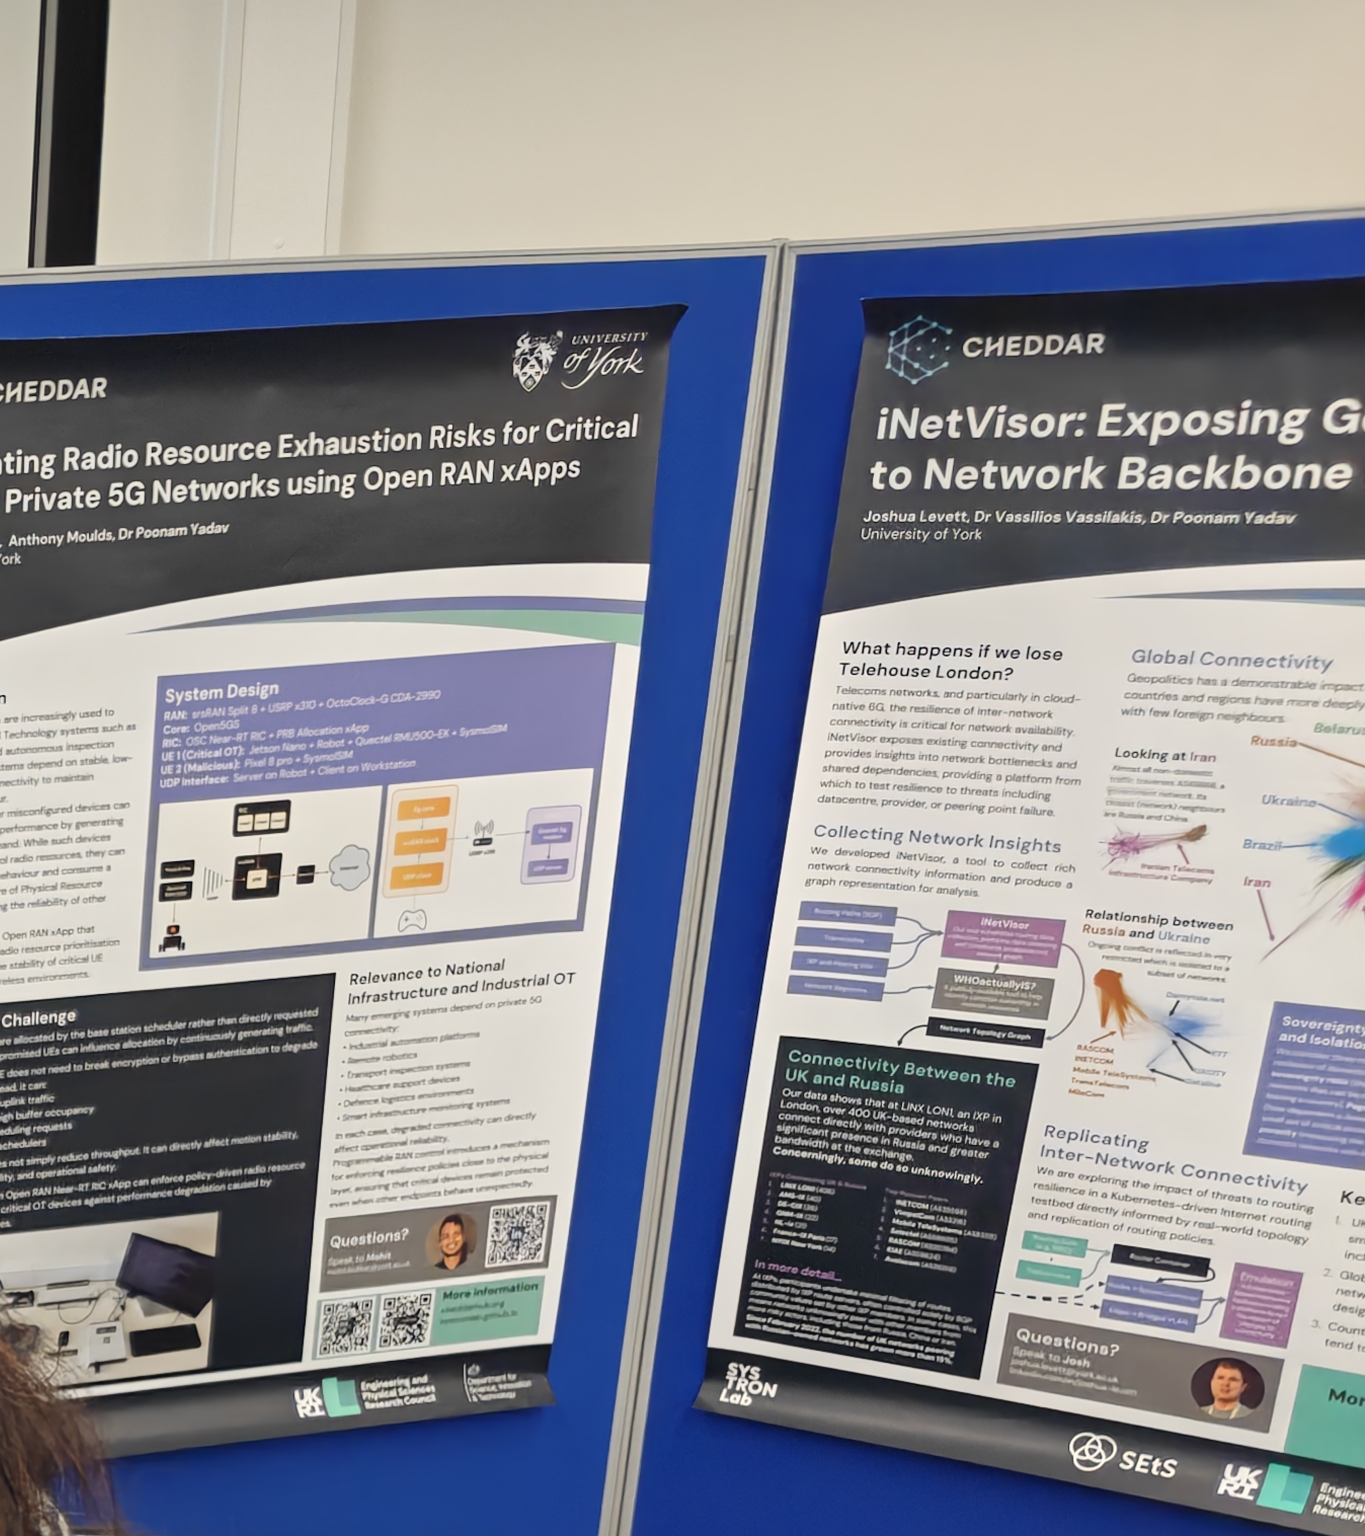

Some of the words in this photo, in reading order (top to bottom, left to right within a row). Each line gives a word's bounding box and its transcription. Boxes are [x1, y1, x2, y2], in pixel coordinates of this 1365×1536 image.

[571, 332, 648, 344] UNIVERSITY
[963, 333, 1105, 358] CHEDDAR
[561, 346, 644, 390] York
[563, 347, 591, 374] of
[877, 405, 1087, 440] iNetVisor:
[1097, 399, 1312, 446] Exposing
[63, 443, 138, 471] Radio
[145, 441, 271, 466] Resource
[277, 427, 422, 458] Exhaustion
[430, 422, 495, 449] Risks
[502, 420, 540, 445] for
[546, 413, 638, 442] Critical
[870, 461, 912, 490] to
[924, 456, 1106, 490] Network
[1117, 454, 1353, 490] Backbone
[5, 486, 101, 513] Private
[108, 481, 145, 507] 5G
[152, 473, 280, 504] Networks
[287, 469, 357, 499] using
[363, 466, 433, 496] Open
[440, 460, 494, 486] RAN
[500, 458, 580, 487] xApps
[863, 510, 916, 522] Joshua
[919, 510, 970, 523] Levett,
[974, 510, 992, 522] Dr
[995, 510, 1061, 523] Vassilios
[1066, 510, 1146, 525] Vassilakis,
[1150, 511, 1170, 523] Dr
[1172, 511, 1241, 524] Poonam
[1244, 511, 1297, 524] Yadav
[8, 533, 65, 547] Anthony
[67, 528, 116, 543] Moulds,
[118, 527, 134, 540] Dr
[135, 526, 188, 539] Poonam
[190, 522, 230, 535] Yadav
[861, 528, 931, 542] University
[934, 528, 949, 540] of
[952, 528, 982, 540] York
[843, 641, 891, 655] What
[896, 641, 973, 660] happens
[978, 644, 991, 658] if
[995, 649, 1021, 659] we
[1026, 646, 1063, 661] lose
[1132, 649, 1195, 665] Global
[1200, 651, 1334, 674] Connectivity
[840, 662, 931, 678] Telehouse
[936, 665, 1014, 681] London?
[165, 687, 223, 705] System
[227, 682, 279, 700] Design
[1251, 735, 1297, 748] Russia
[1115, 747, 1169, 763] Looking
[1172, 752, 1186, 761] at
[1190, 752, 1216, 762] Iran
[1261, 794, 1317, 807] Ukraine
[814, 824, 904, 846] Collecting
[909, 830, 984, 848] Network
[989, 835, 1061, 855] Insights
[1243, 839, 1283, 851] Brazil
[1243, 876, 1271, 888] Iran
[1085, 909, 1169, 928] Relationship
[1172, 916, 1234, 931] between
[1082, 923, 1125, 937] Russia
[1128, 929, 1155, 940] and
[1158, 931, 1210, 944] Ukraine
[350, 970, 423, 985] Relevance
[428, 967, 442, 978] to
[445, 958, 505, 976] National
[348, 987, 448, 1005] Infrastructure
[451, 980, 479, 995] and
[482, 973, 550, 991] Industrial
[553, 972, 576, 985] OT
[1, 1011, 76, 1028] Challenge
[787, 1049, 900, 1076] Connectivity
[904, 1062, 981, 1084] Between
[986, 1072, 1016, 1088] the
[785, 1068, 809, 1083] UK
[813, 1074, 846, 1087] and
[849, 1075, 904, 1094] Russia
[1044, 1125, 1149, 1154] Replicating
[772, 1146, 846, 1165] Concerningly,
[848, 1157, 878, 1168] some
[879, 1161, 894, 1171] do
[896, 1162, 909, 1173] so
[911, 1166, 983, 1185] unknowingly.
[1040, 1144, 1175, 1175] Inter-Network
[1181, 1164, 1308, 1196] Connectivity
[330, 1228, 409, 1250] Questions?
[443, 1290, 471, 1300] More
[473, 1282, 539, 1296] information
[1016, 1328, 1120, 1357] Questions?
[727, 1362, 761, 1380] SYS
[719, 1388, 753, 1406] Lab
[725, 1375, 778, 1398] TRON
[1119, 1450, 1179, 1478] SEtS
